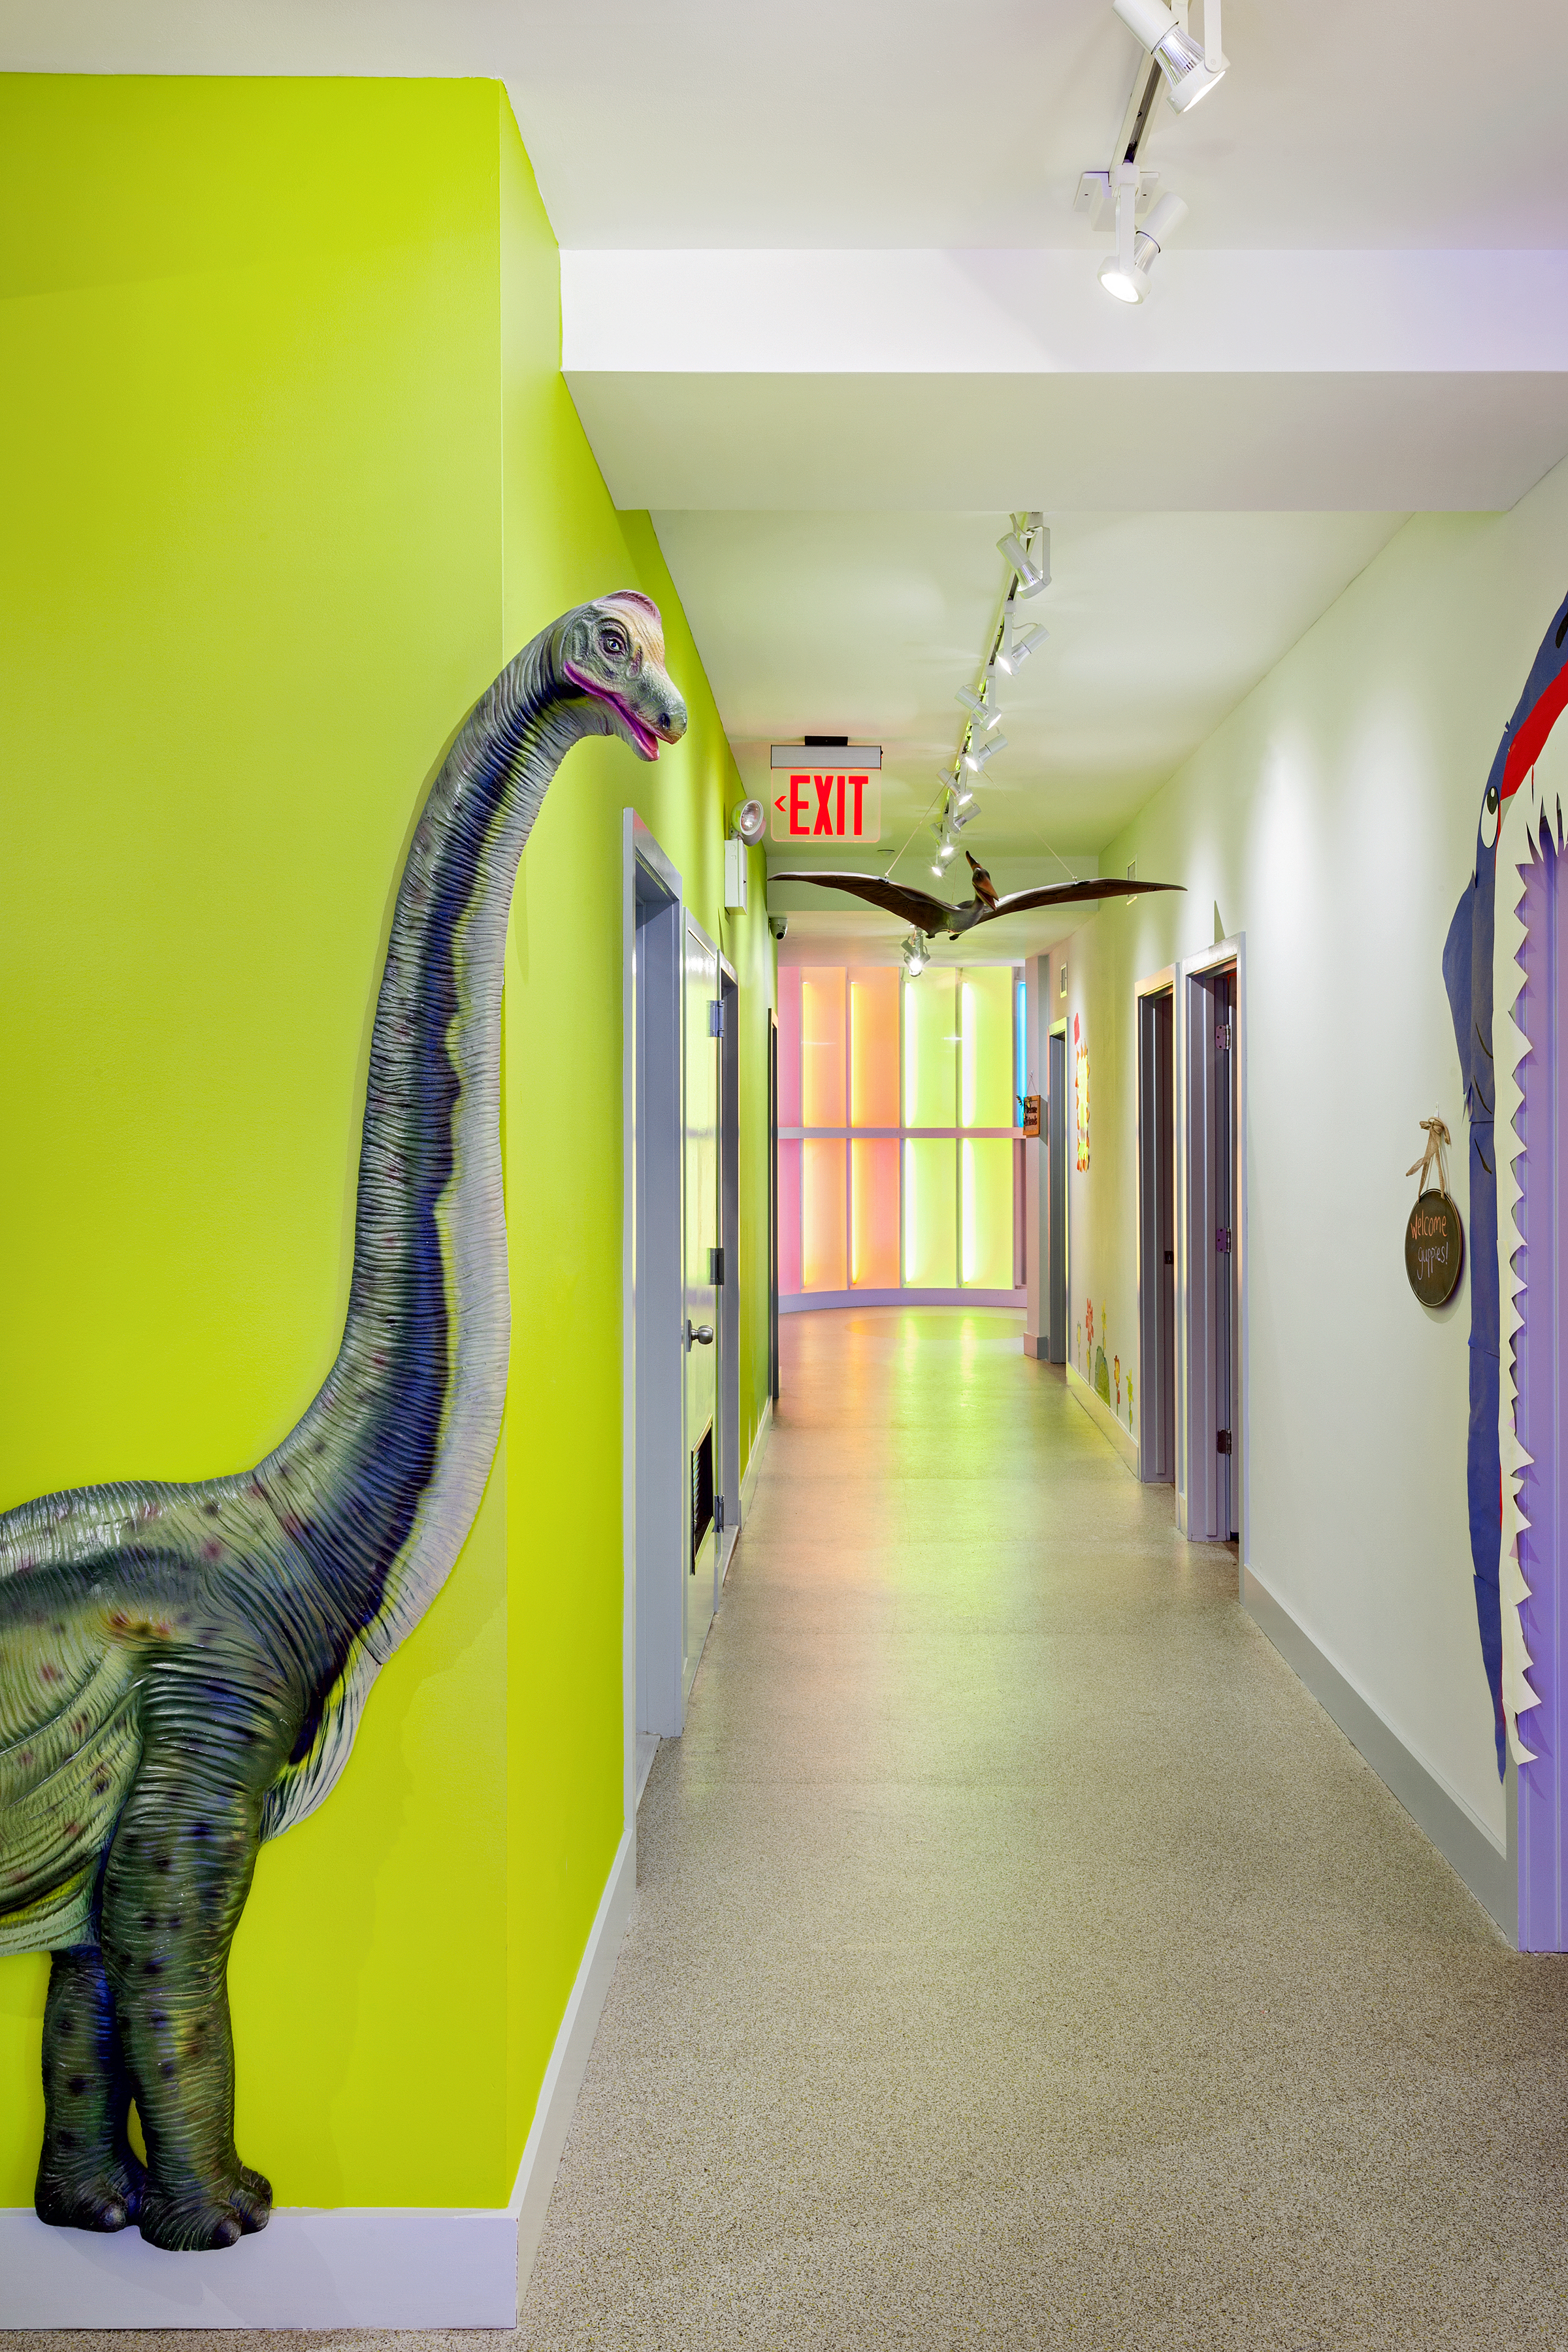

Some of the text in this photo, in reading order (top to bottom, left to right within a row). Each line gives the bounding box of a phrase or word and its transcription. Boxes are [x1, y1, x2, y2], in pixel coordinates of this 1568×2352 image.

[789, 774, 869, 836] EXIT
[1410, 1209, 1448, 1240] Welcome
[1416, 1241, 1449, 1281] guppies!
